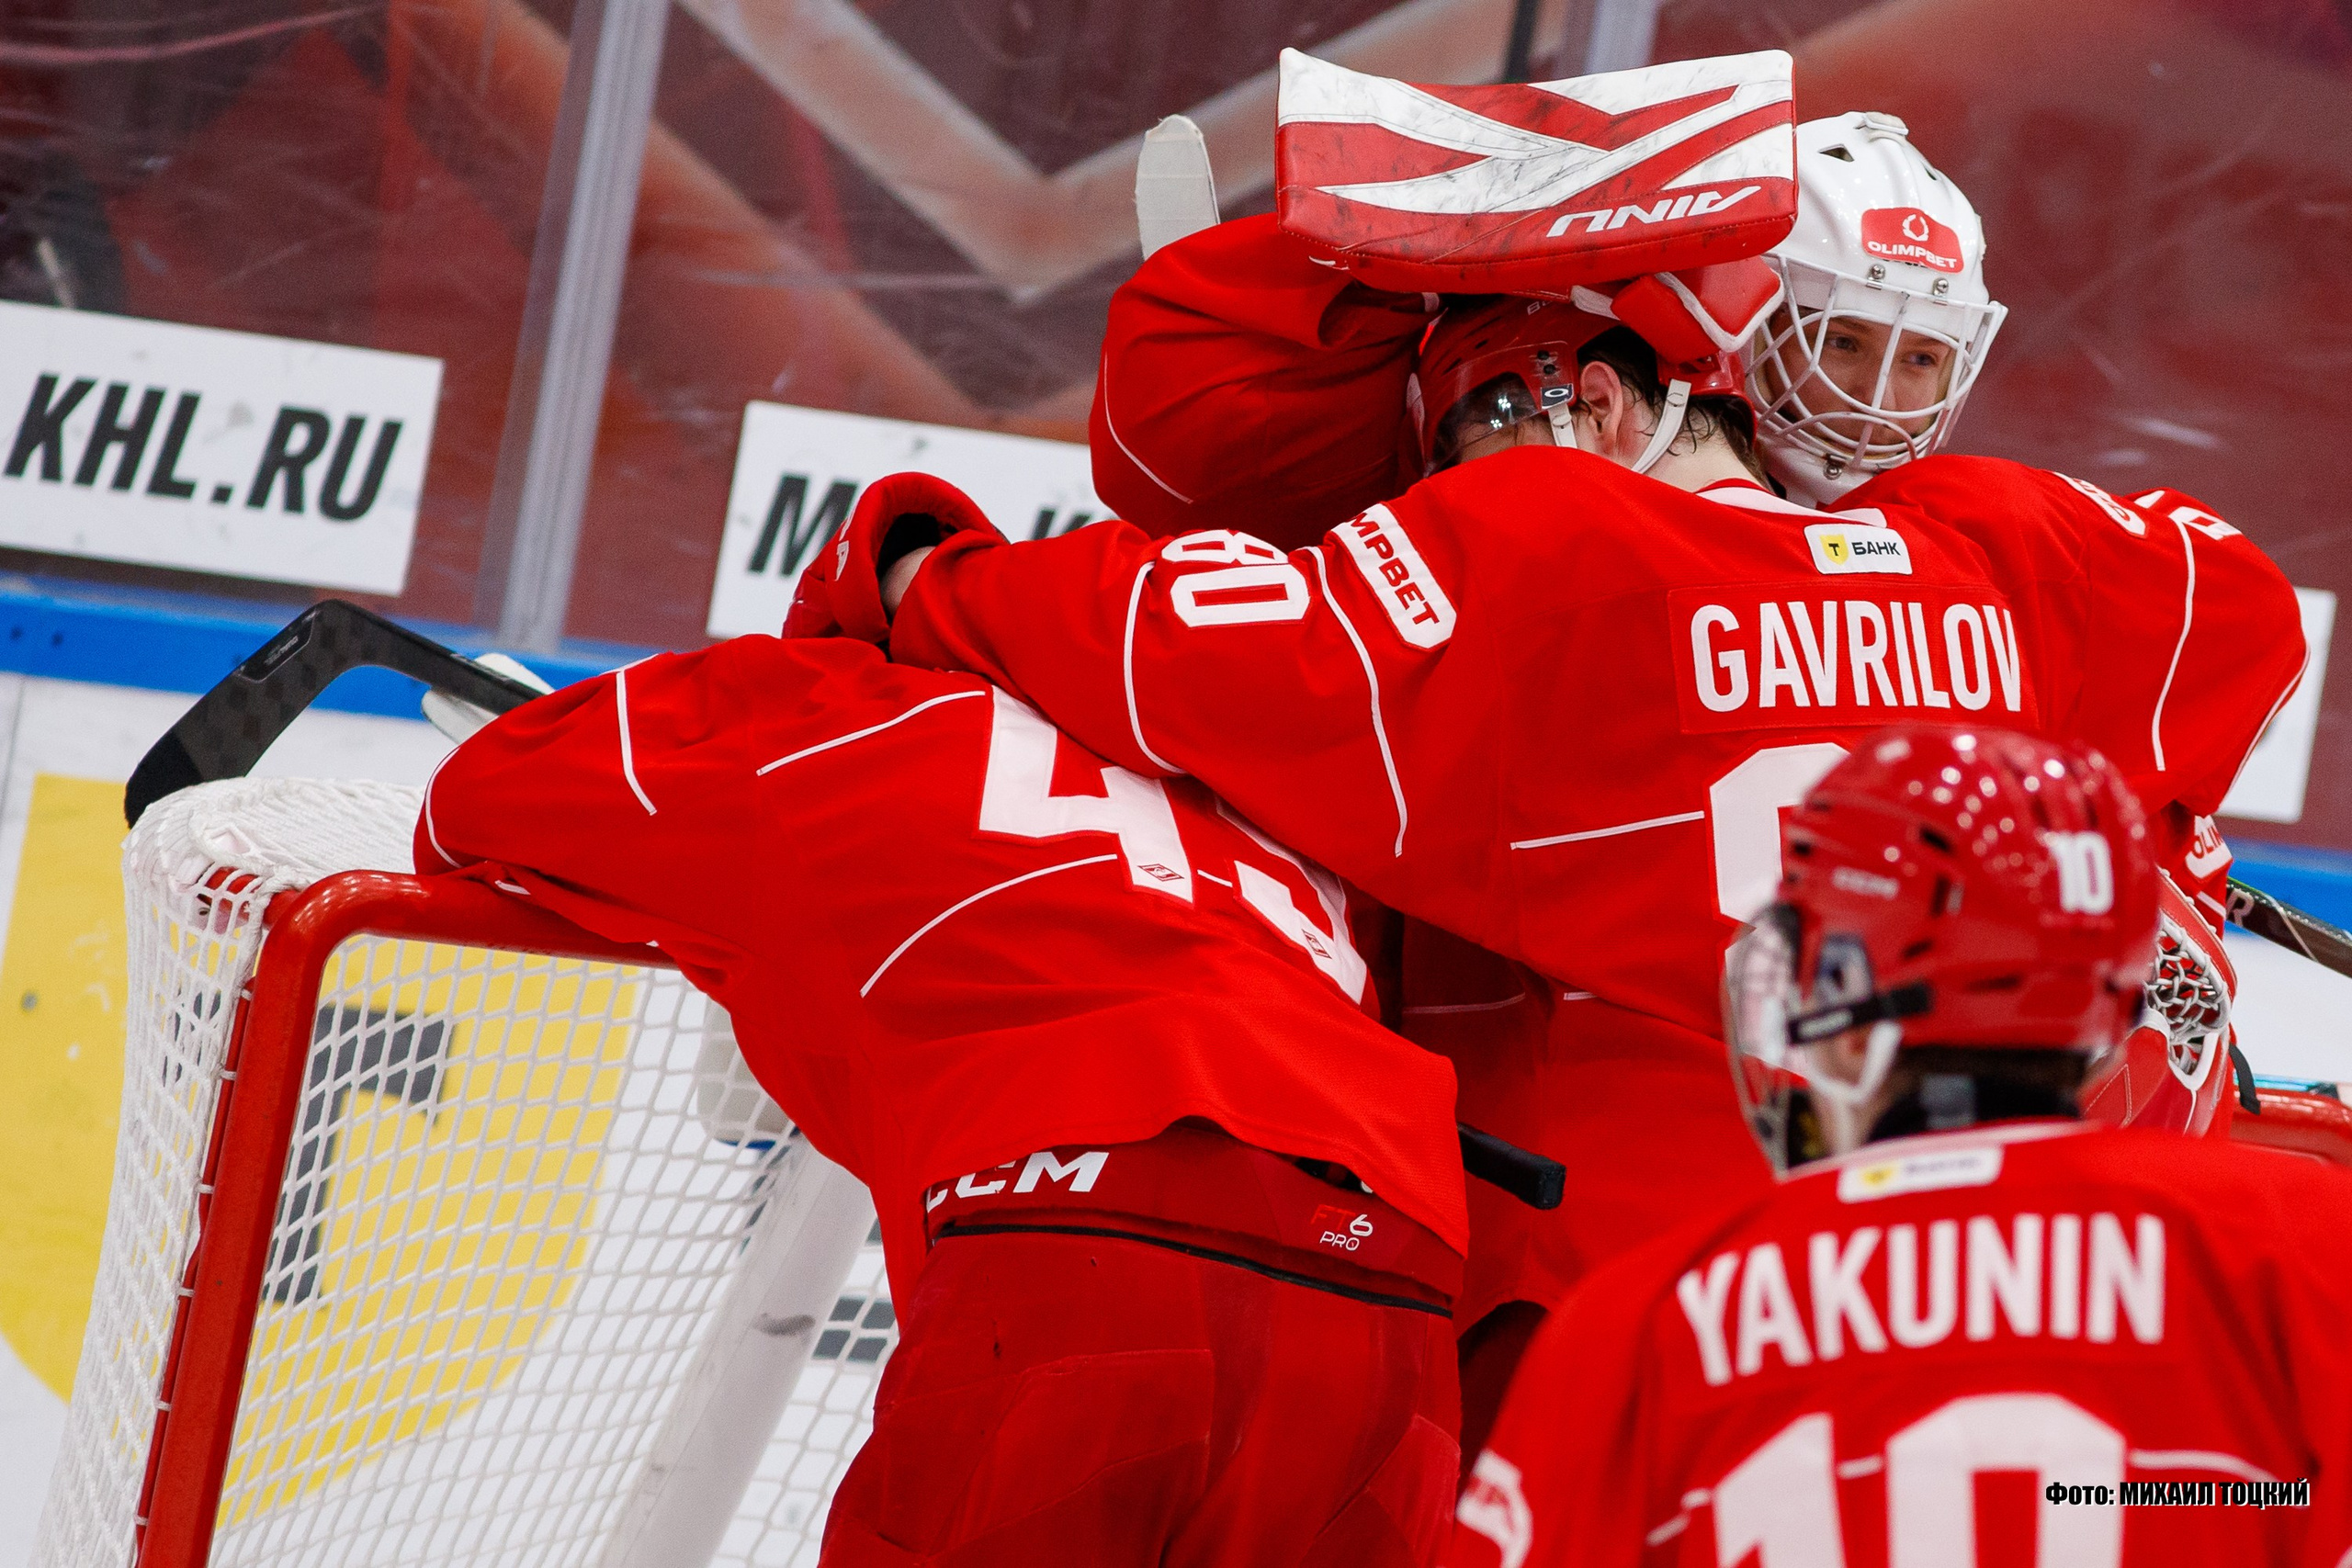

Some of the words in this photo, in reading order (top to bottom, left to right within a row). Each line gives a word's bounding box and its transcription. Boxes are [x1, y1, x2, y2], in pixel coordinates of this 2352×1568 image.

[1867, 240, 1957, 268] OLIMPBET
[3, 371, 404, 522] KHL.RU
[1349, 512, 1441, 627] MPBET
[1851, 541, 1901, 557] БАНК
[1690, 600, 2022, 713] GAVRILOV
[2048, 830, 2114, 915] 10
[1310, 1203, 1374, 1237] FT6
[1319, 1231, 1360, 1251] PRO
[1677, 1212, 2165, 1387] YAKUNIN
